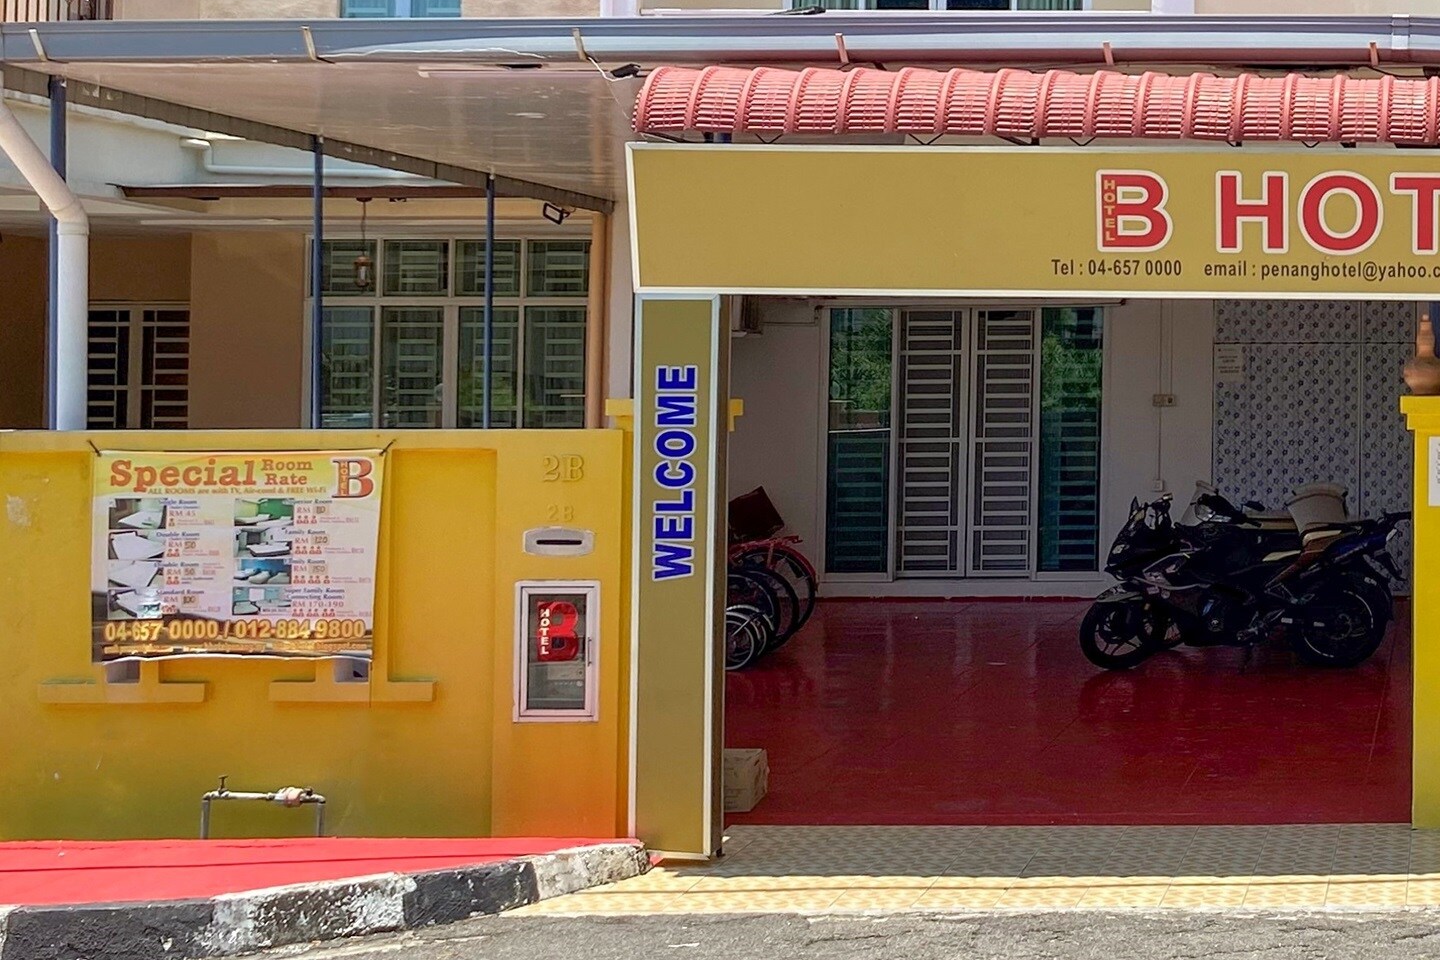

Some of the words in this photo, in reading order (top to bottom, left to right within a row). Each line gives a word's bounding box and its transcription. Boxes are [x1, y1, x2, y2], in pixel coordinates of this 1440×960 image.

[1097, 169, 1173, 252] B
[1104, 180, 1115, 242] HOTEL
[1052, 260, 1074, 276] Tel
[1088, 260, 1141, 276] 04-657
[1145, 260, 1182, 276] 0000
[1204, 261, 1247, 277] email
[110, 458, 256, 492] Special
[261, 459, 313, 471] Room
[265, 473, 307, 486] Rate
[332, 458, 374, 499] B
[542, 454, 584, 482] 2B
[652, 365, 698, 581] WELCOME
[105, 620, 163, 640] 04-657
[169, 620, 218, 640] 0000
[235, 619, 310, 640] 012-884
[315, 619, 365, 639] 9800
[538, 601, 578, 661] B
[540, 608, 550, 655] HOTEL
